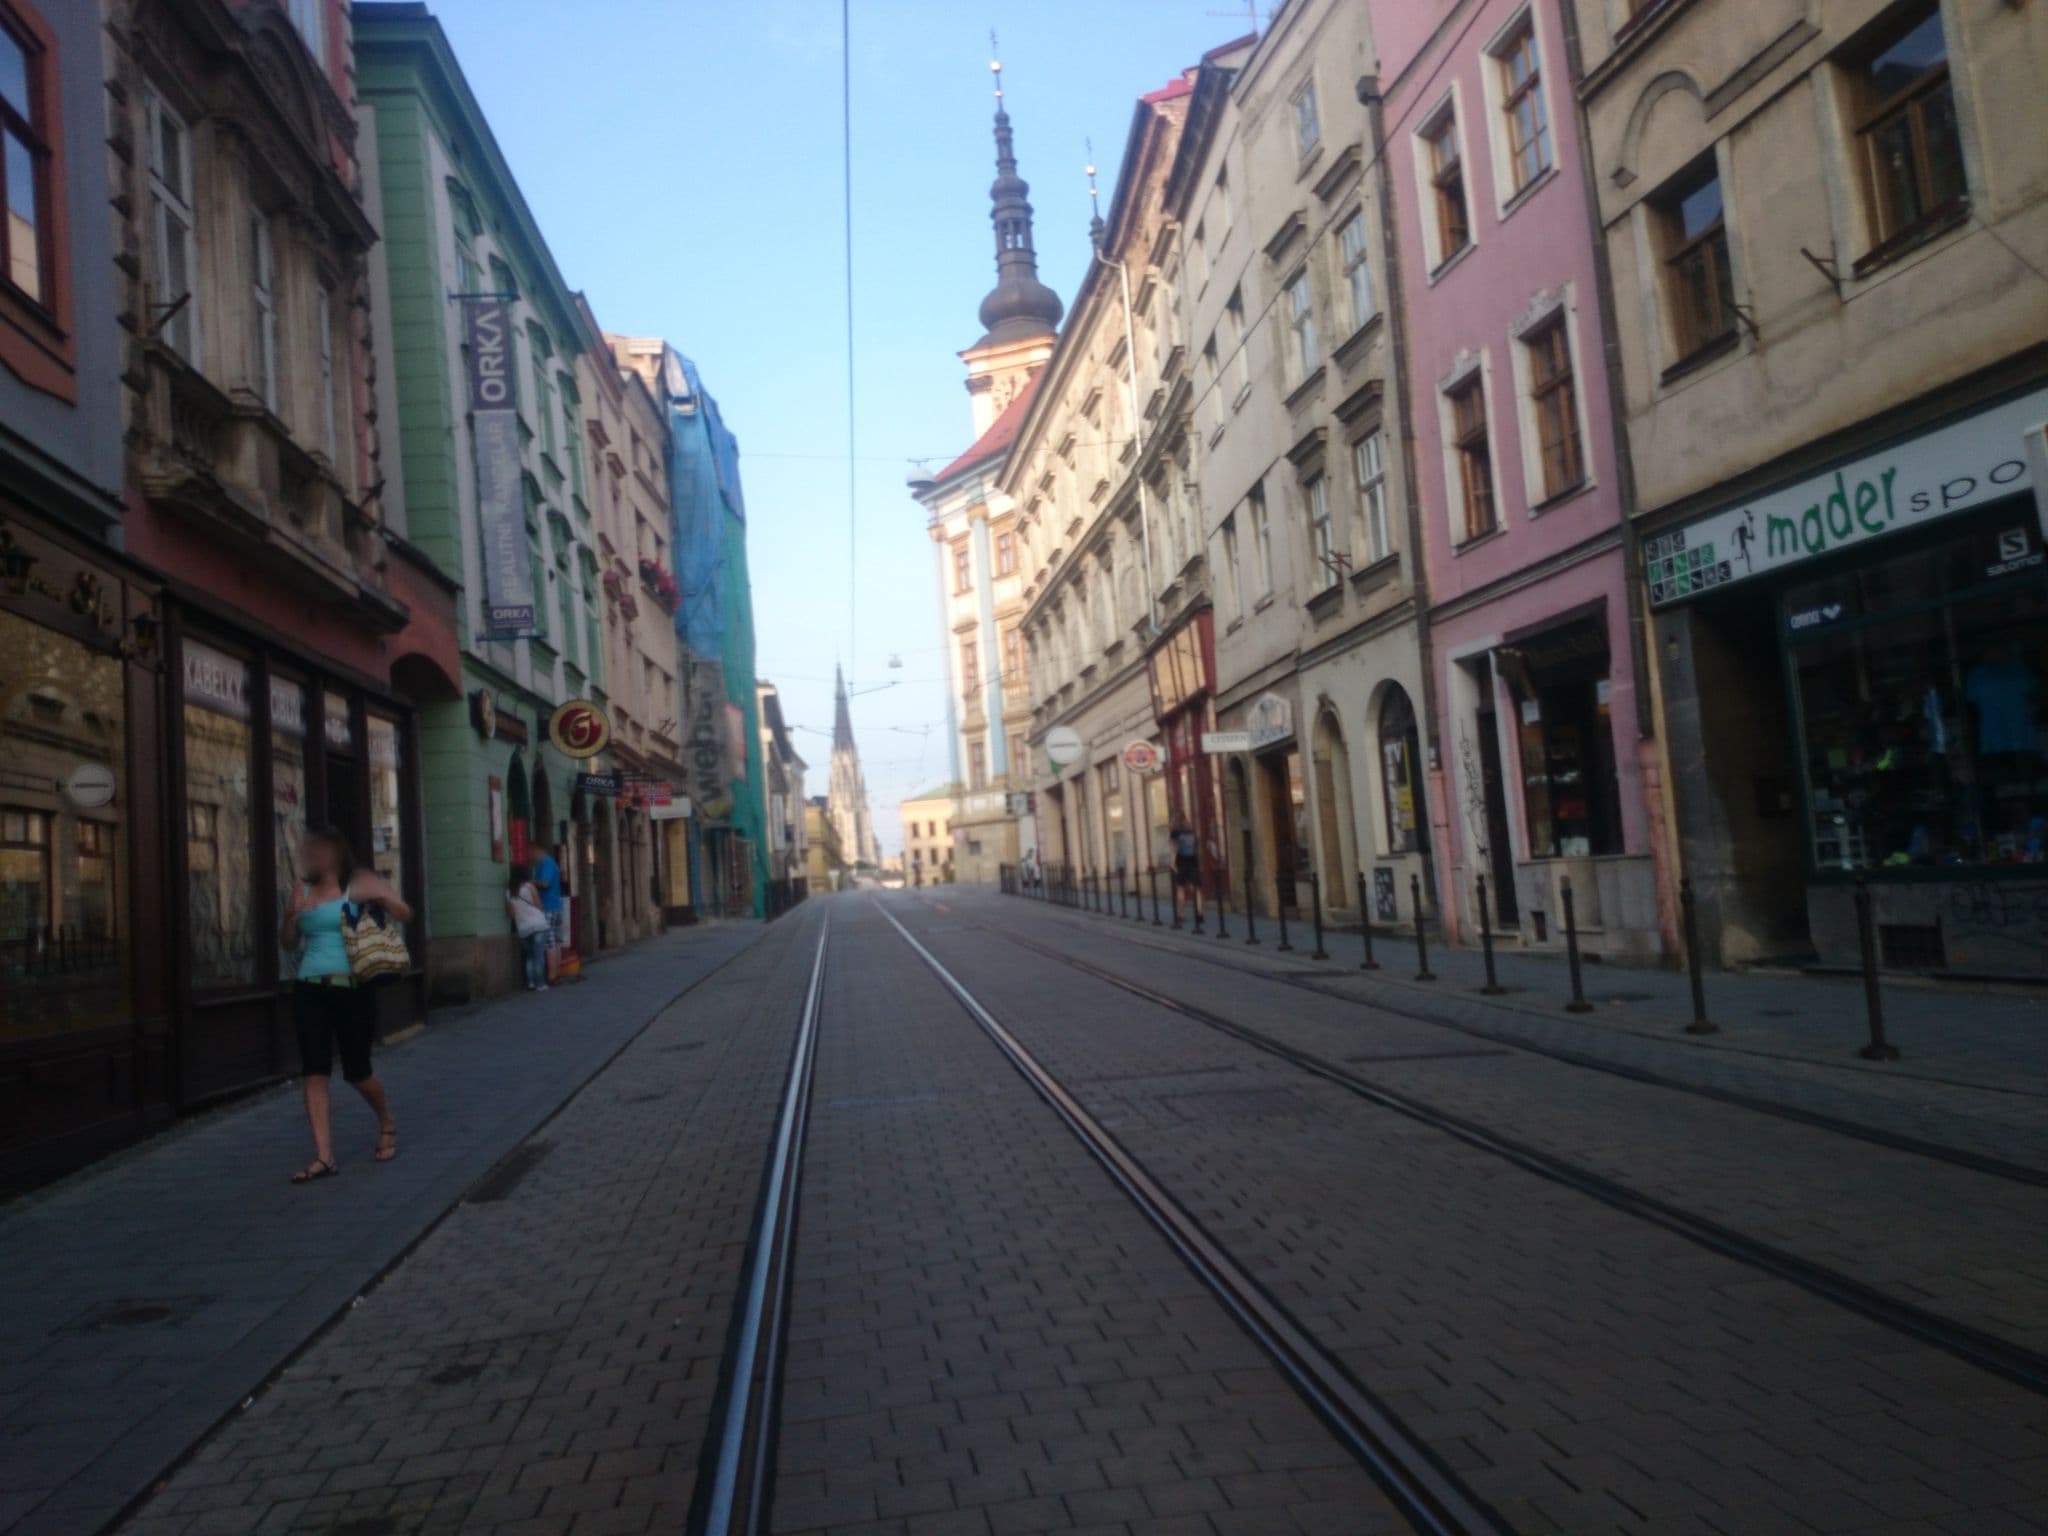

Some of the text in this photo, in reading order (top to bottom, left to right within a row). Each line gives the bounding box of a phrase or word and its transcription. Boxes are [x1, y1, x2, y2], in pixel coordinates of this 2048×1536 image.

[475, 308, 507, 402] ORKA
[1766, 466, 1897, 557] mader
[492, 607, 530, 620] ORKA
[183, 655, 242, 705] KABELKY
